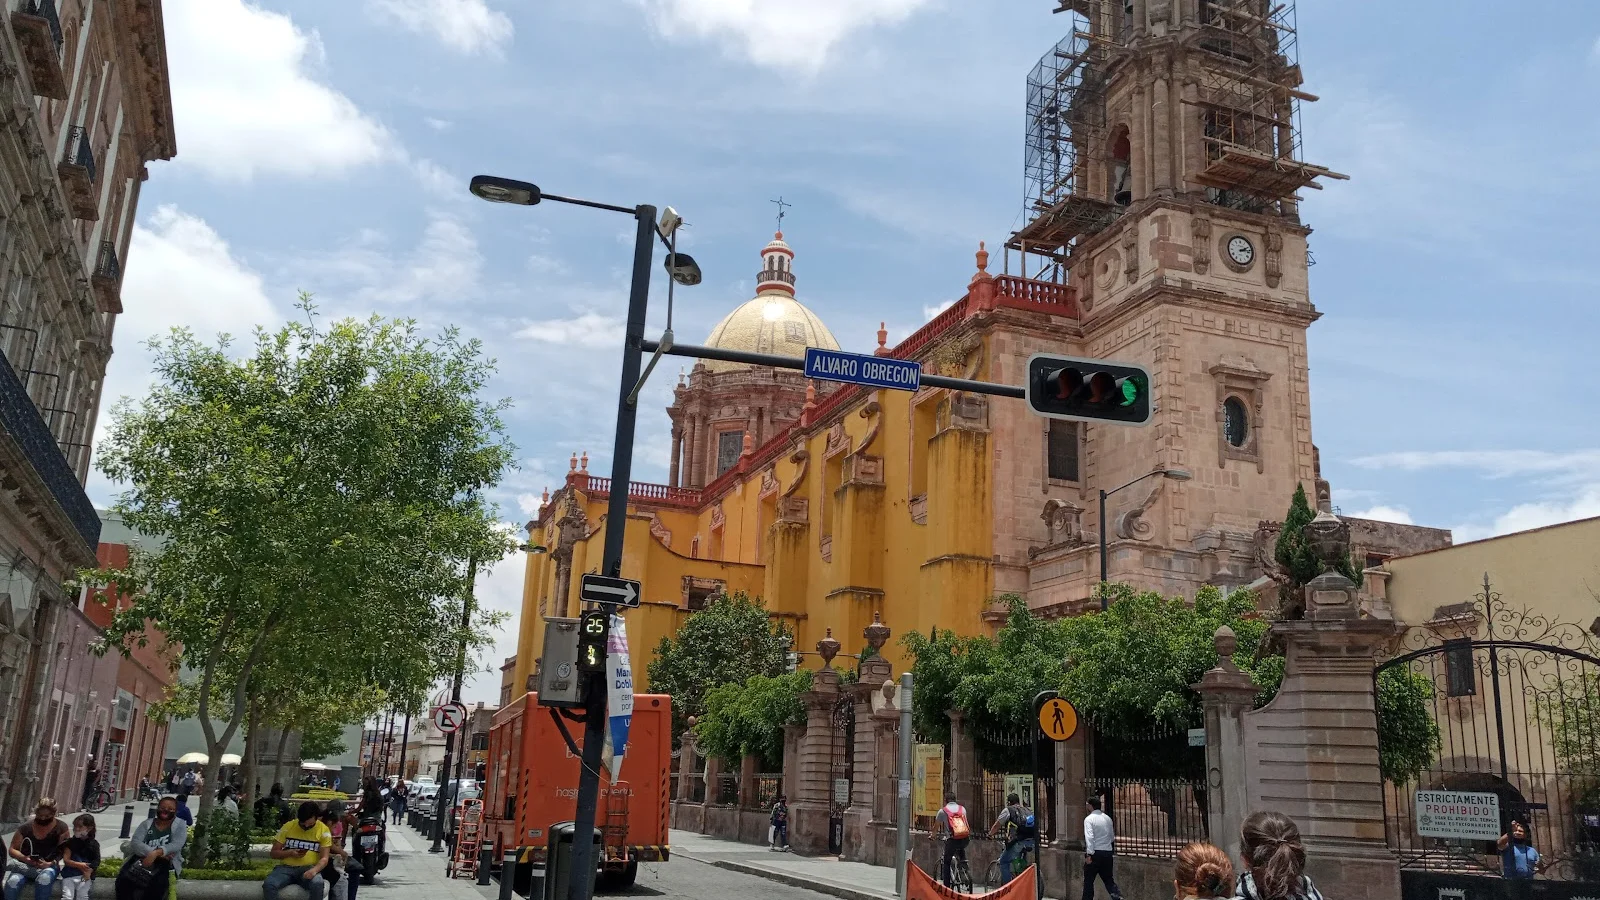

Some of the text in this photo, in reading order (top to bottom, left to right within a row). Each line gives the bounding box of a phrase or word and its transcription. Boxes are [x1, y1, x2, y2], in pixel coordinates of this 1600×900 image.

[812, 355, 918, 385] ALVARO OBREGON
[586, 618, 604, 633] 25
[1417, 793, 1496, 806] ESTRICTAMENTE
[1426, 804, 1489, 816] PROHIBIDO
